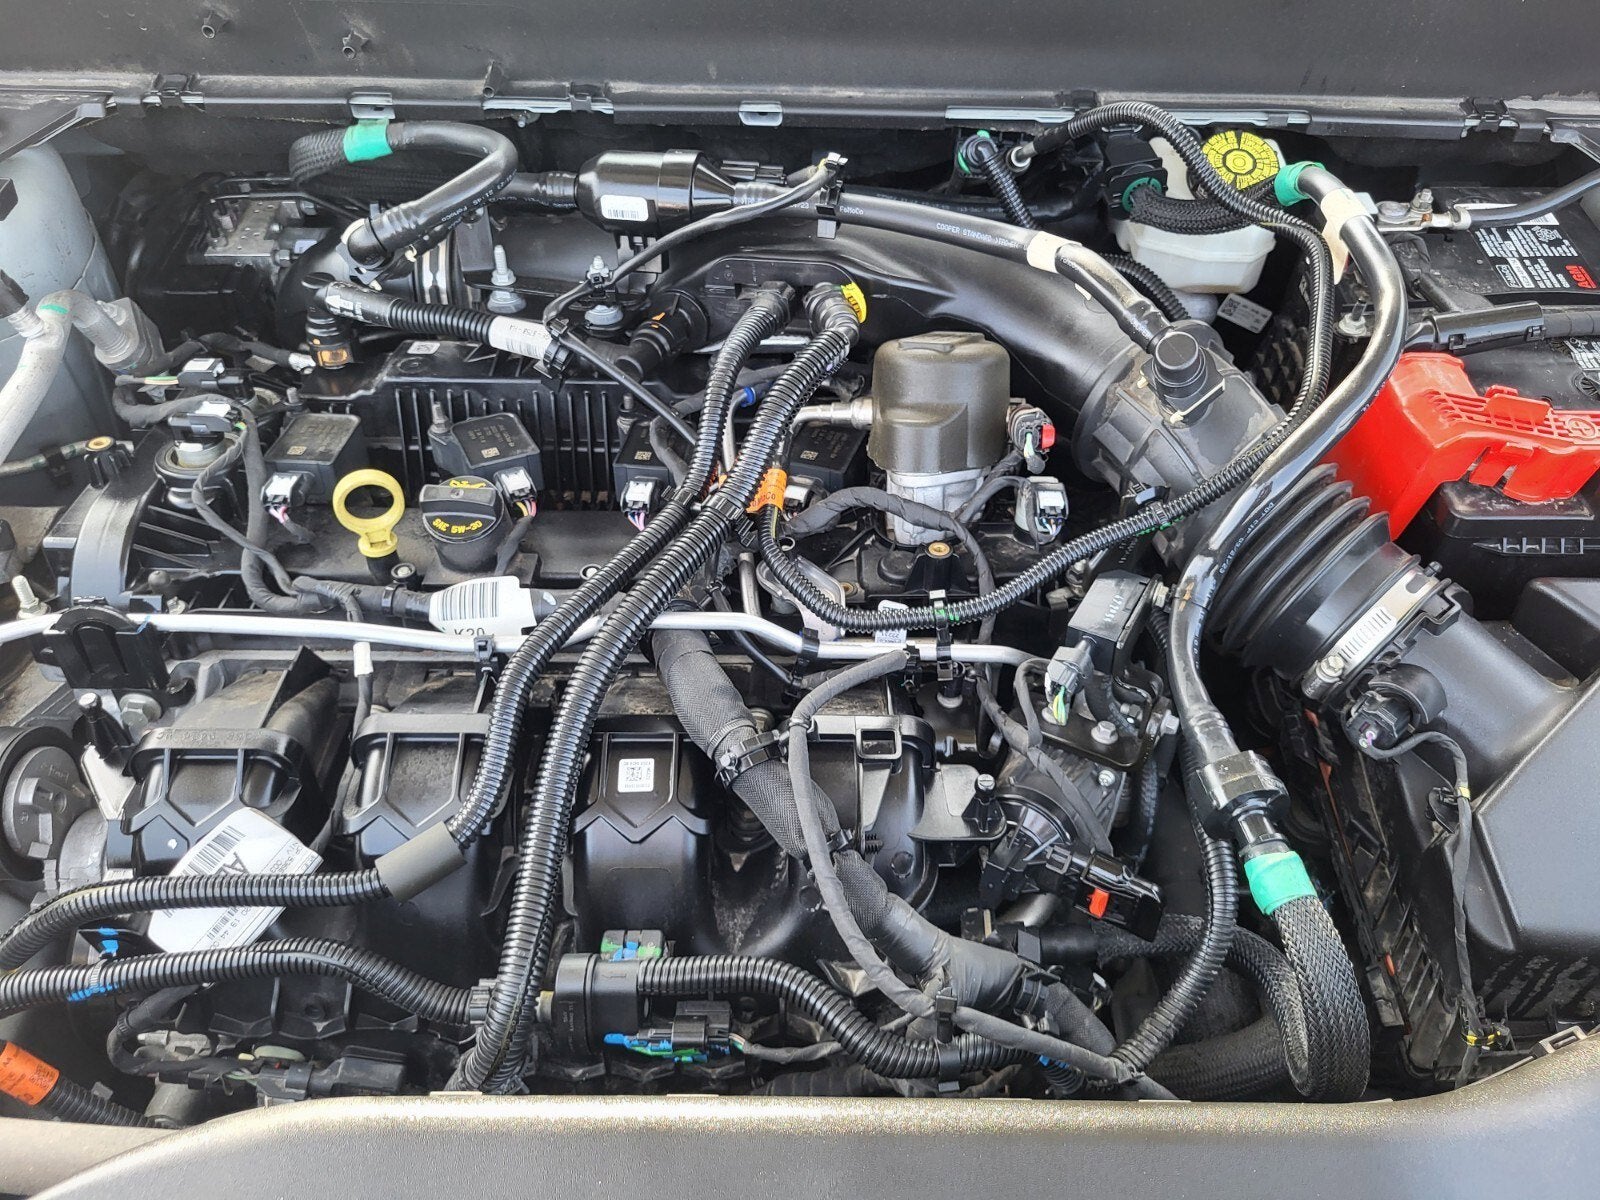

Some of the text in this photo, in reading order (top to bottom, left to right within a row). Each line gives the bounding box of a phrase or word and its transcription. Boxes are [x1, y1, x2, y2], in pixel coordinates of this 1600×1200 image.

[839, 205, 864, 216] FoMoCo
[936, 222, 961, 235] COOPER
[1565, 265, 1592, 288] AGM
[432, 518, 483, 534] SAE 5W-30
